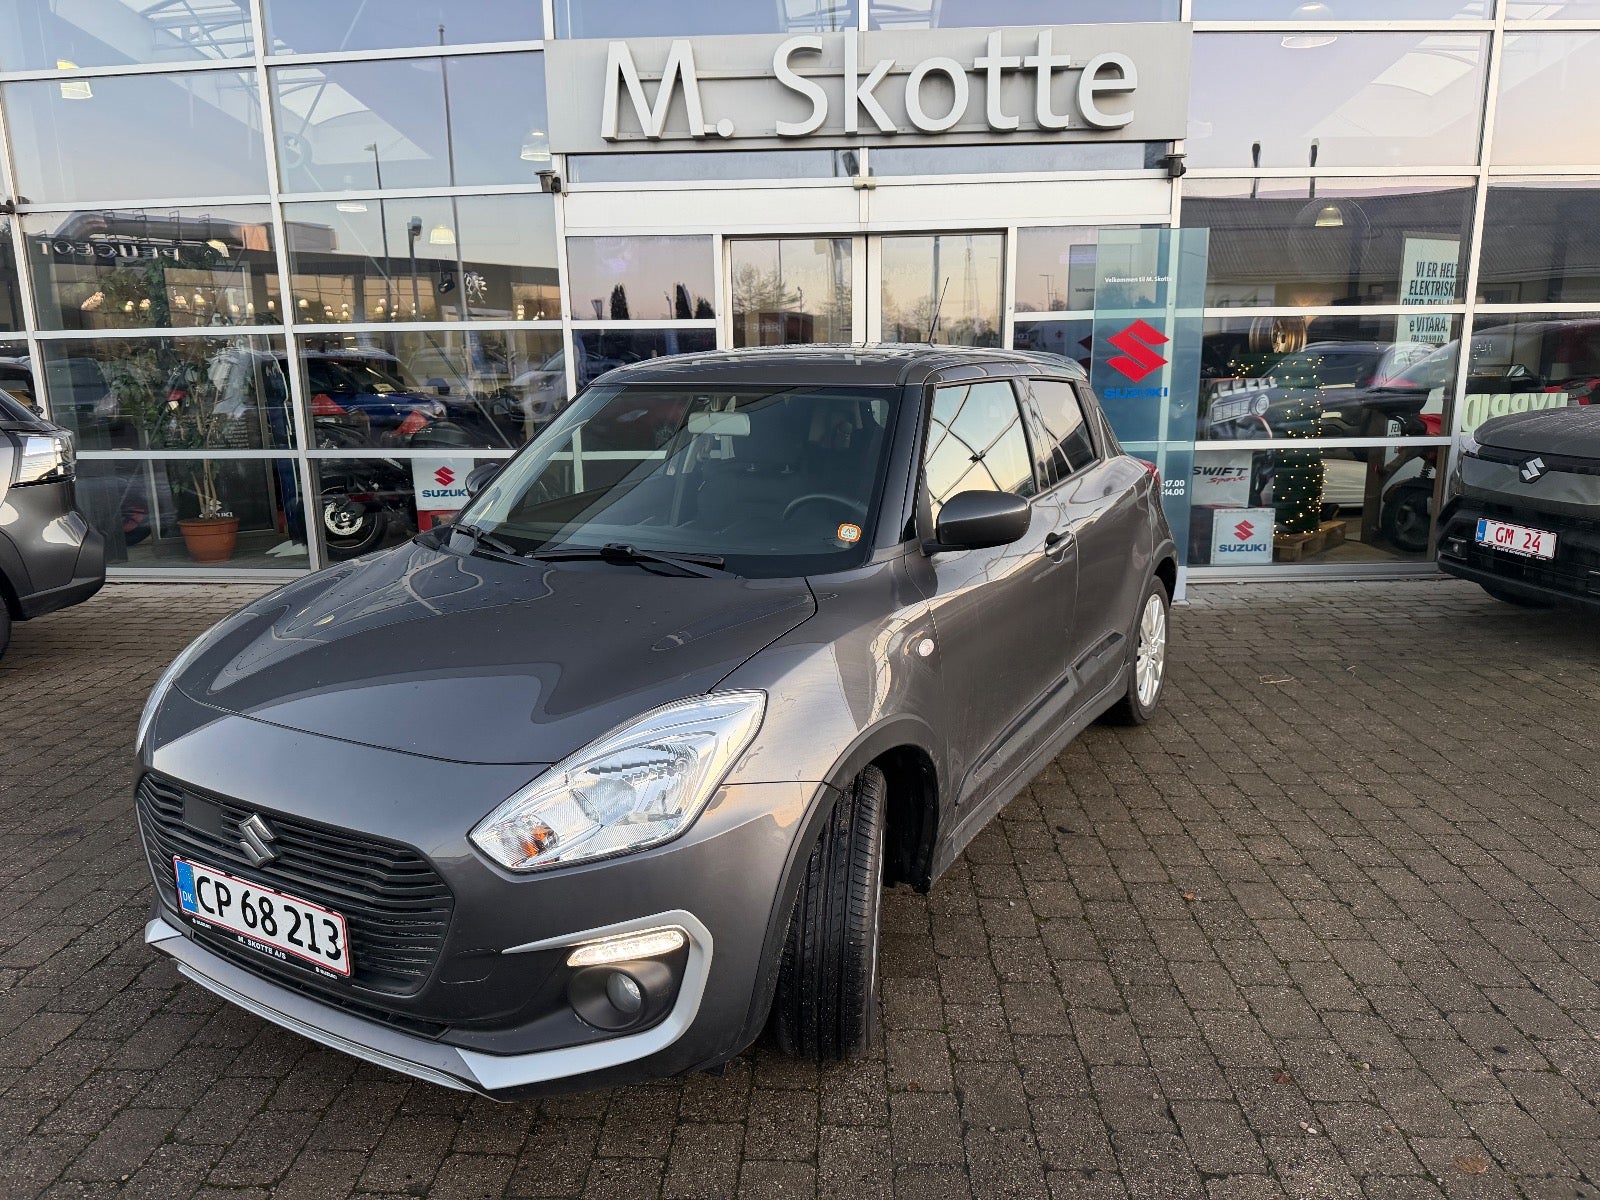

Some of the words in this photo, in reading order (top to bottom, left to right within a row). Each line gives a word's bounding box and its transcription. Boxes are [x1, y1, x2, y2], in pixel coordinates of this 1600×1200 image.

[601, 40, 735, 142] M.
[773, 27, 1138, 138] Skotte
[1416, 261, 1425, 277] VI
[1426, 262, 1438, 278] ER
[1408, 280, 1456, 297] ELEKTRISK
[1409, 320, 1415, 332] e
[1416, 316, 1448, 332] VITARA.
[1104, 387, 1168, 399] SUZUKI
[1192, 466, 1248, 476] SWIFT
[1206, 475, 1248, 485] Sport
[422, 489, 468, 498] SUZUK
[1495, 526, 1515, 546] GM
[1523, 532, 1541, 551] 24
[1219, 543, 1266, 553] SUZUKI
[182, 890, 194, 904] DK
[196, 876, 232, 917] CP
[241, 890, 278, 937] 68
[284, 904, 342, 961] 213
[237, 935, 246, 944] M.
[247, 939, 273, 955] SKOTTE
[274, 950, 287, 960] A/S
